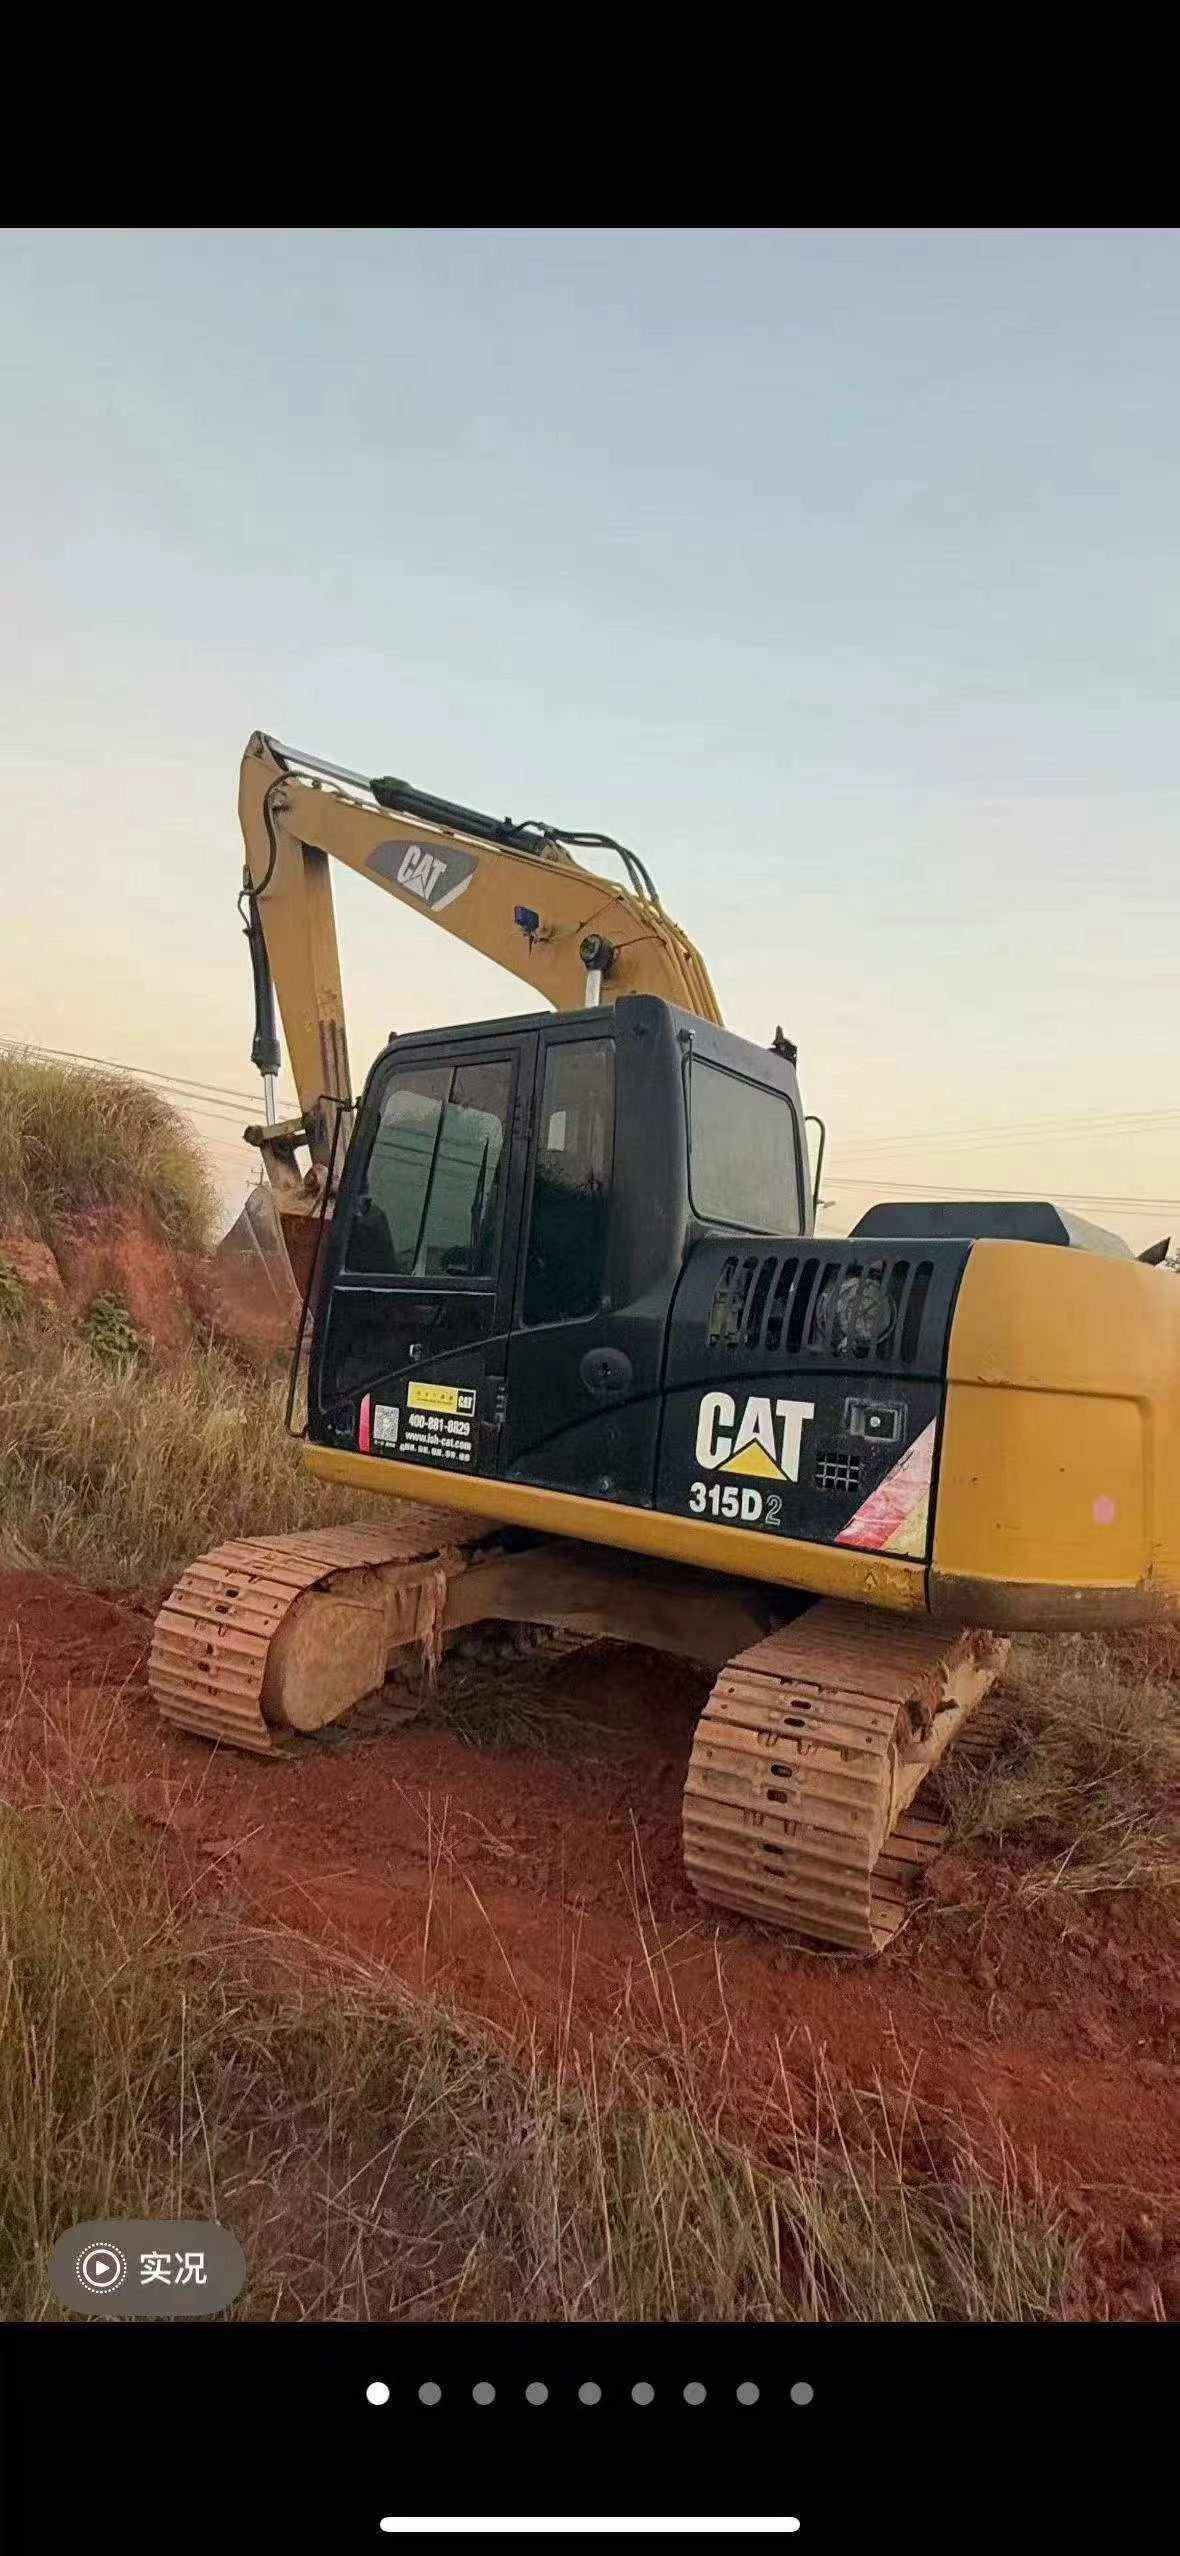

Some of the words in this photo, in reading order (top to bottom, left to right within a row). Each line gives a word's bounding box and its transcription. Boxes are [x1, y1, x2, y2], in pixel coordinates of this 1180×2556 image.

[397, 845, 447, 900] CAT
[458, 1396, 473, 1409] CAT
[695, 1391, 815, 1483] CAT
[688, 1481, 783, 1526] 315D2
